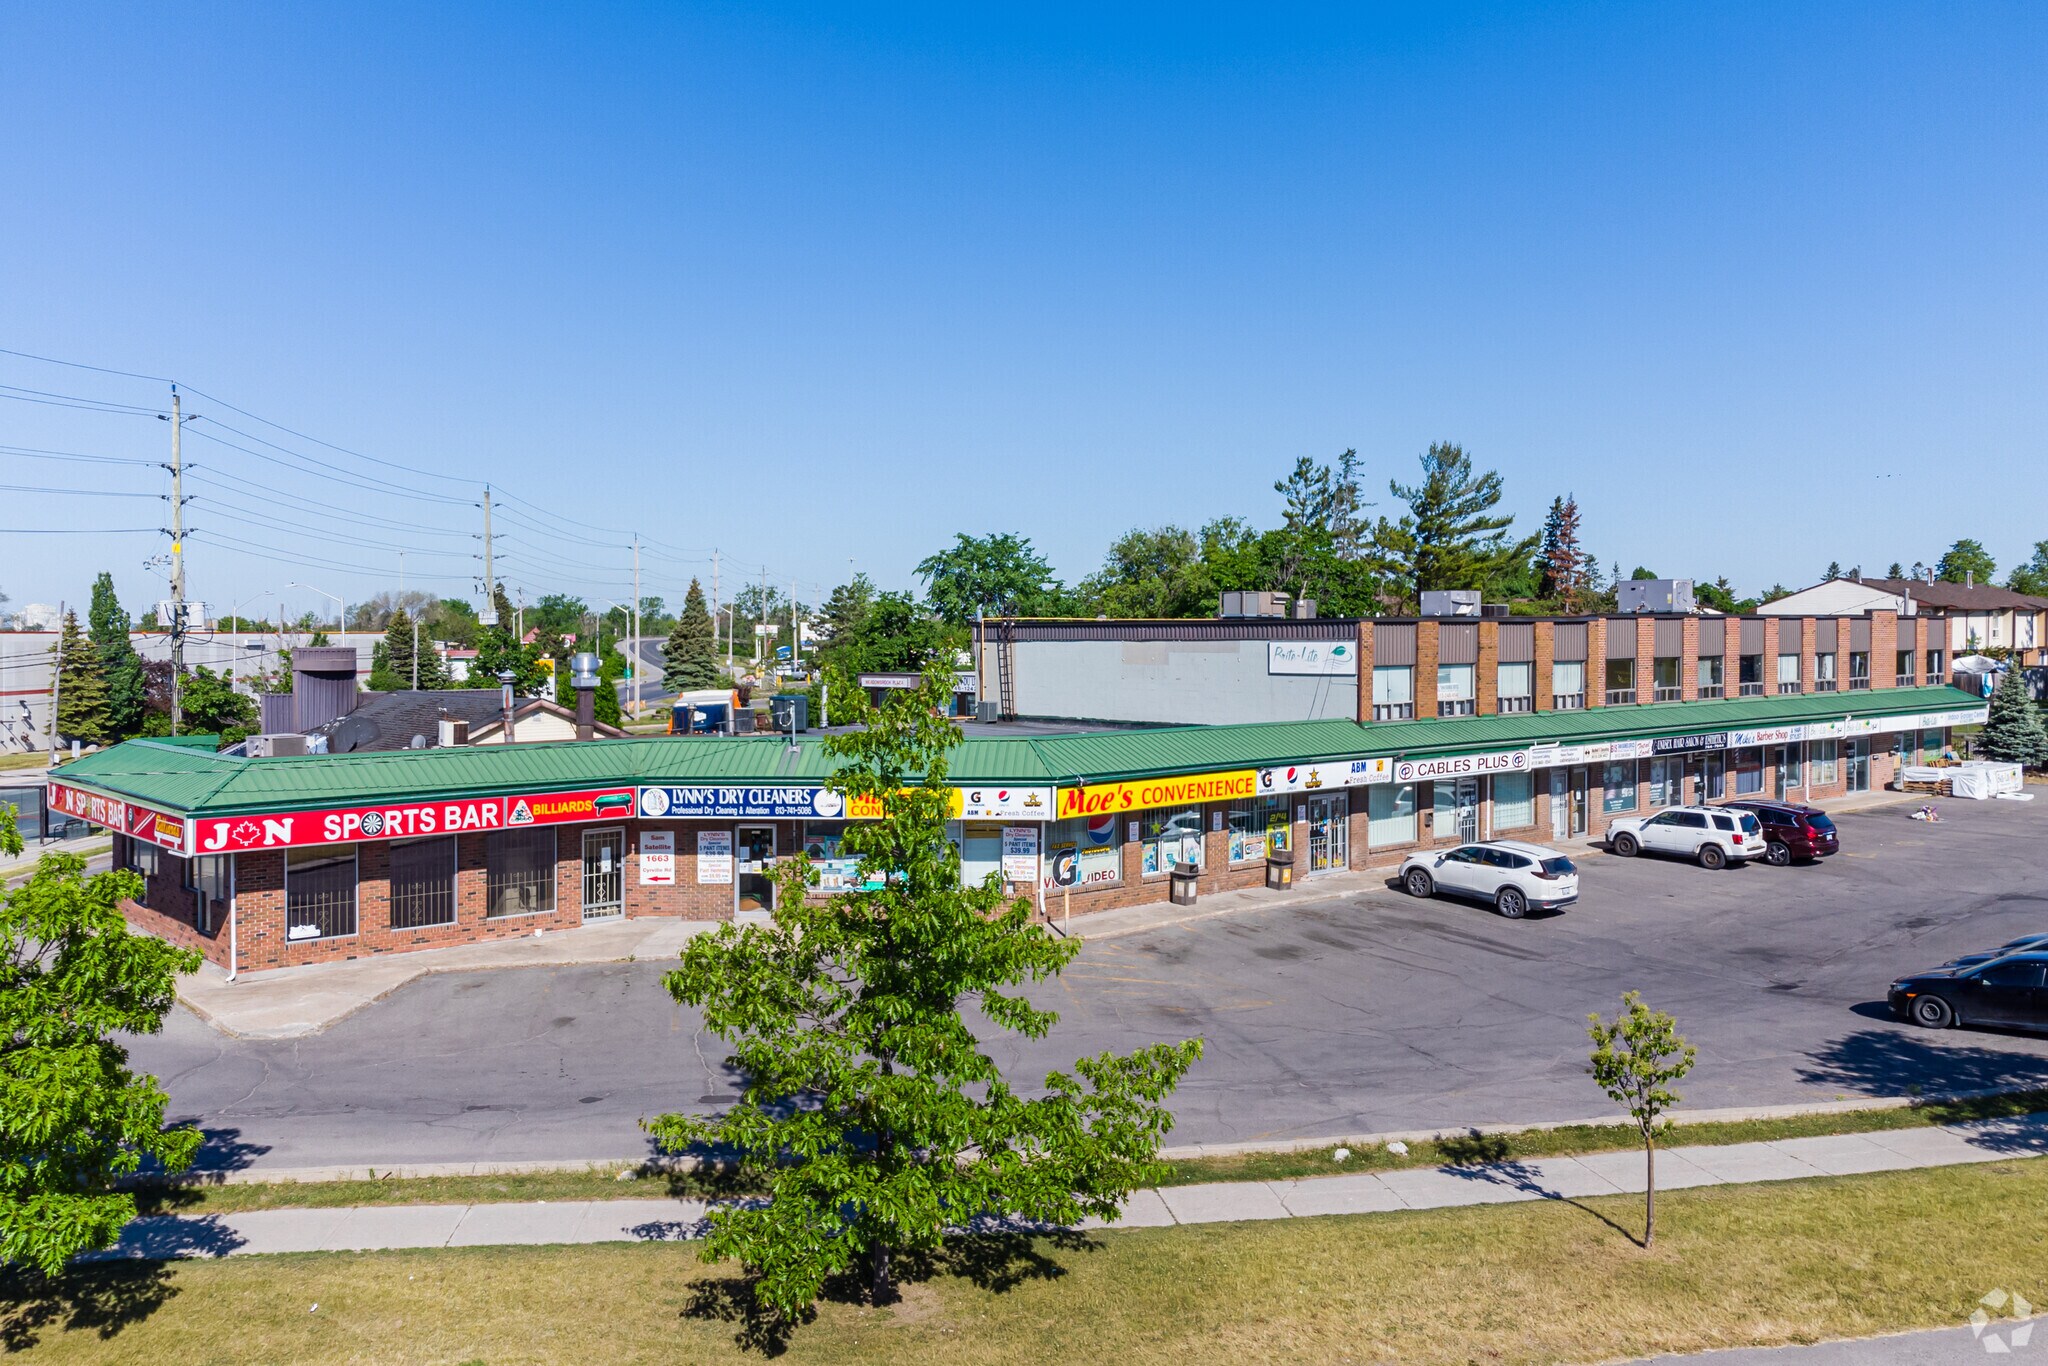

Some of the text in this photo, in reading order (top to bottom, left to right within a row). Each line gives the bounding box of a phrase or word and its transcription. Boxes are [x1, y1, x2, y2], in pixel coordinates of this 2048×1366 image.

[1757, 731, 1774, 741] Barber
[1775, 729, 1788, 741] Shop
[1351, 761, 1367, 773] ABM
[1417, 759, 1471, 776] CABLES
[1477, 755, 1509, 770] PLUS
[1349, 772, 1390, 785] Fresh Coffee
[672, 788, 811, 805] LYNN'S DRY CLEANERS
[1062, 777, 1253, 816] Moe's CONVENIENCE
[75, 792, 106, 823] SPRTS
[533, 800, 592, 815] BILLIARDS
[671, 805, 703, 814] Professional
[704, 806, 714, 816] Dry
[715, 805, 738, 816] Cleaning
[738, 806, 744, 815] &
[774, 806, 813, 815] 613-741-5086
[1000, 809, 1045, 817] Fresh Coffee
[323, 807, 436, 841] SPORTS
[444, 803, 498, 830] BAR
